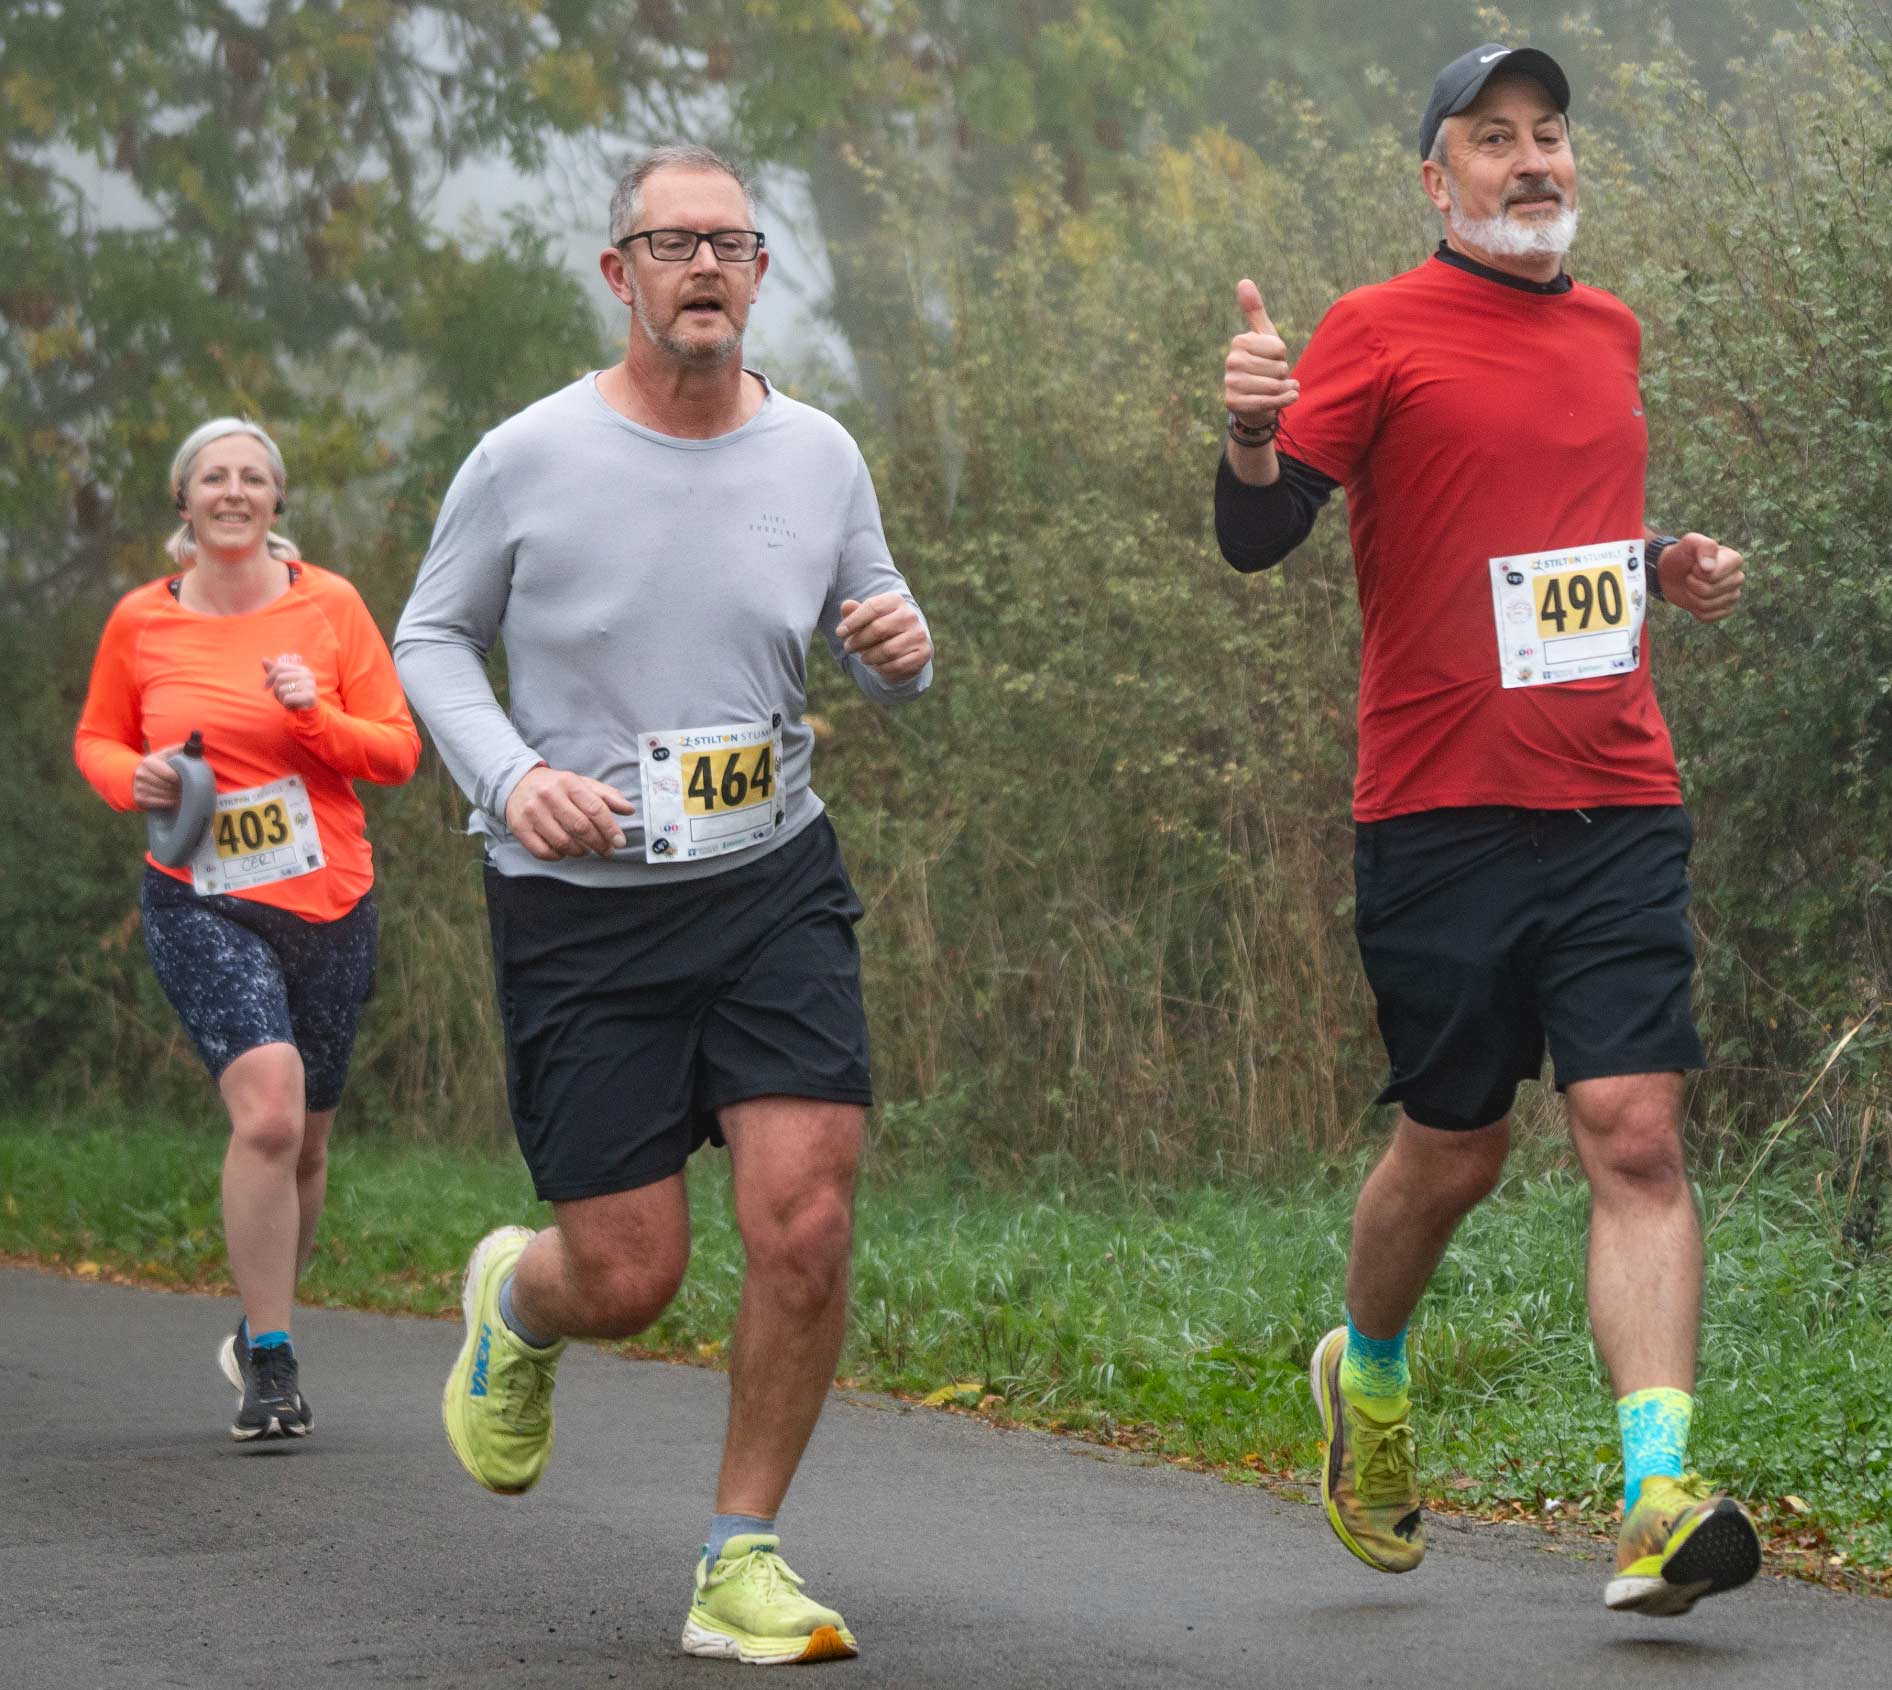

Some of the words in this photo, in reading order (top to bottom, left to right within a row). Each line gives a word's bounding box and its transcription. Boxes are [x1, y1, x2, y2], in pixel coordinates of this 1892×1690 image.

[1540, 570, 1624, 633] 490
[694, 733, 738, 746] STILTON
[687, 746, 773, 811] 464
[216, 803, 289, 855] 403
